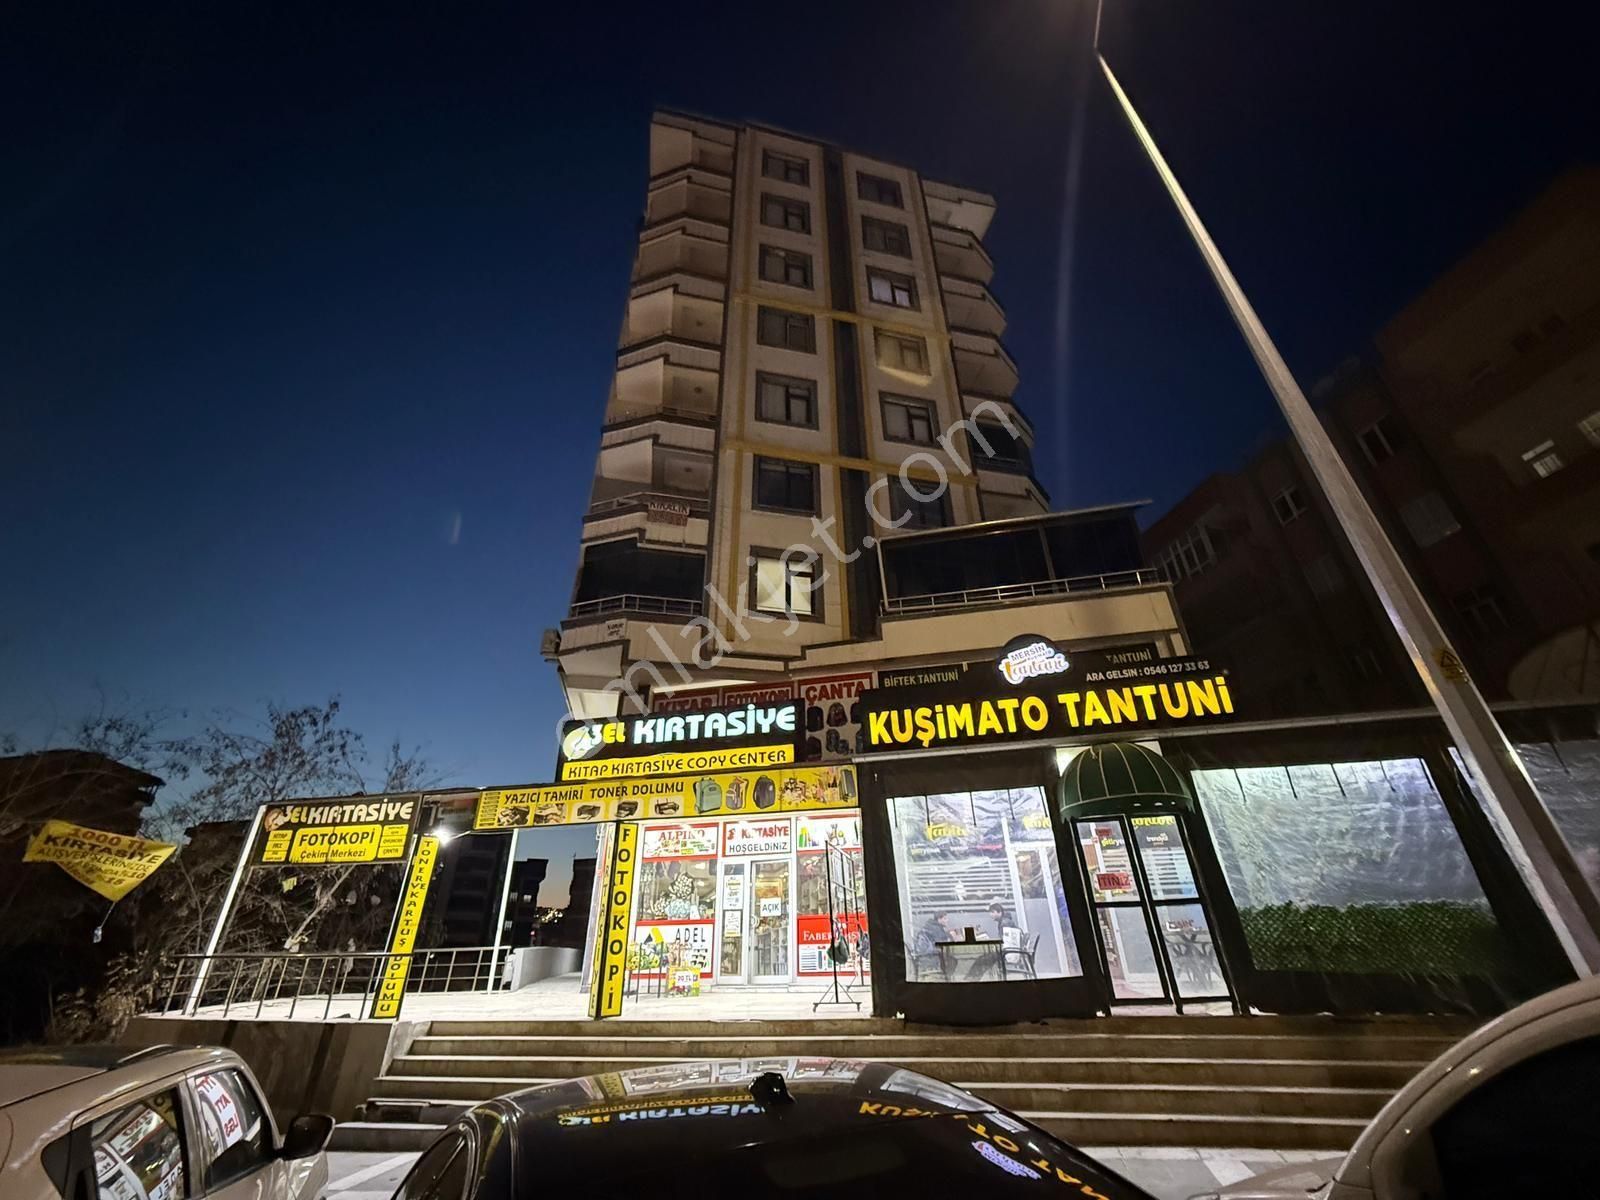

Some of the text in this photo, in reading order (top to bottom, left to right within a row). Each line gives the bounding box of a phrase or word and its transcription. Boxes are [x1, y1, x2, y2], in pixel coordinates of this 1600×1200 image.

[883, 668, 958, 687] BİFTEK TANTUNİ
[1086, 672, 1105, 682] ARA
[1144, 665, 1168, 676] 0546
[1168, 663, 1183, 673] 127
[1184, 662, 1196, 671] 33
[1197, 660, 1210, 670] 63
[805, 679, 866, 704] ÇANTA
[869, 675, 1235, 748] KUŞİMATO TANTUNİ
[633, 703, 796, 745] KIRTASİYE
[568, 749, 787, 778] KİTAP KIRTASİYE COPY CENTER
[503, 781, 684, 805] YAZICI TAMİRİ TONER DOLUMU
[307, 798, 414, 824] KIRTASİYE
[299, 828, 376, 847] FOTOKOPİ
[729, 842, 788, 854] HOŞGELDİNİZ
[43, 835, 163, 865] KIRTASİYE
[300, 847, 367, 861] Çekim Merkezi
[607, 827, 631, 1010] FOTOKOPİ
[762, 903, 780, 913] AÇIK
[675, 927, 706, 943] ADEL
